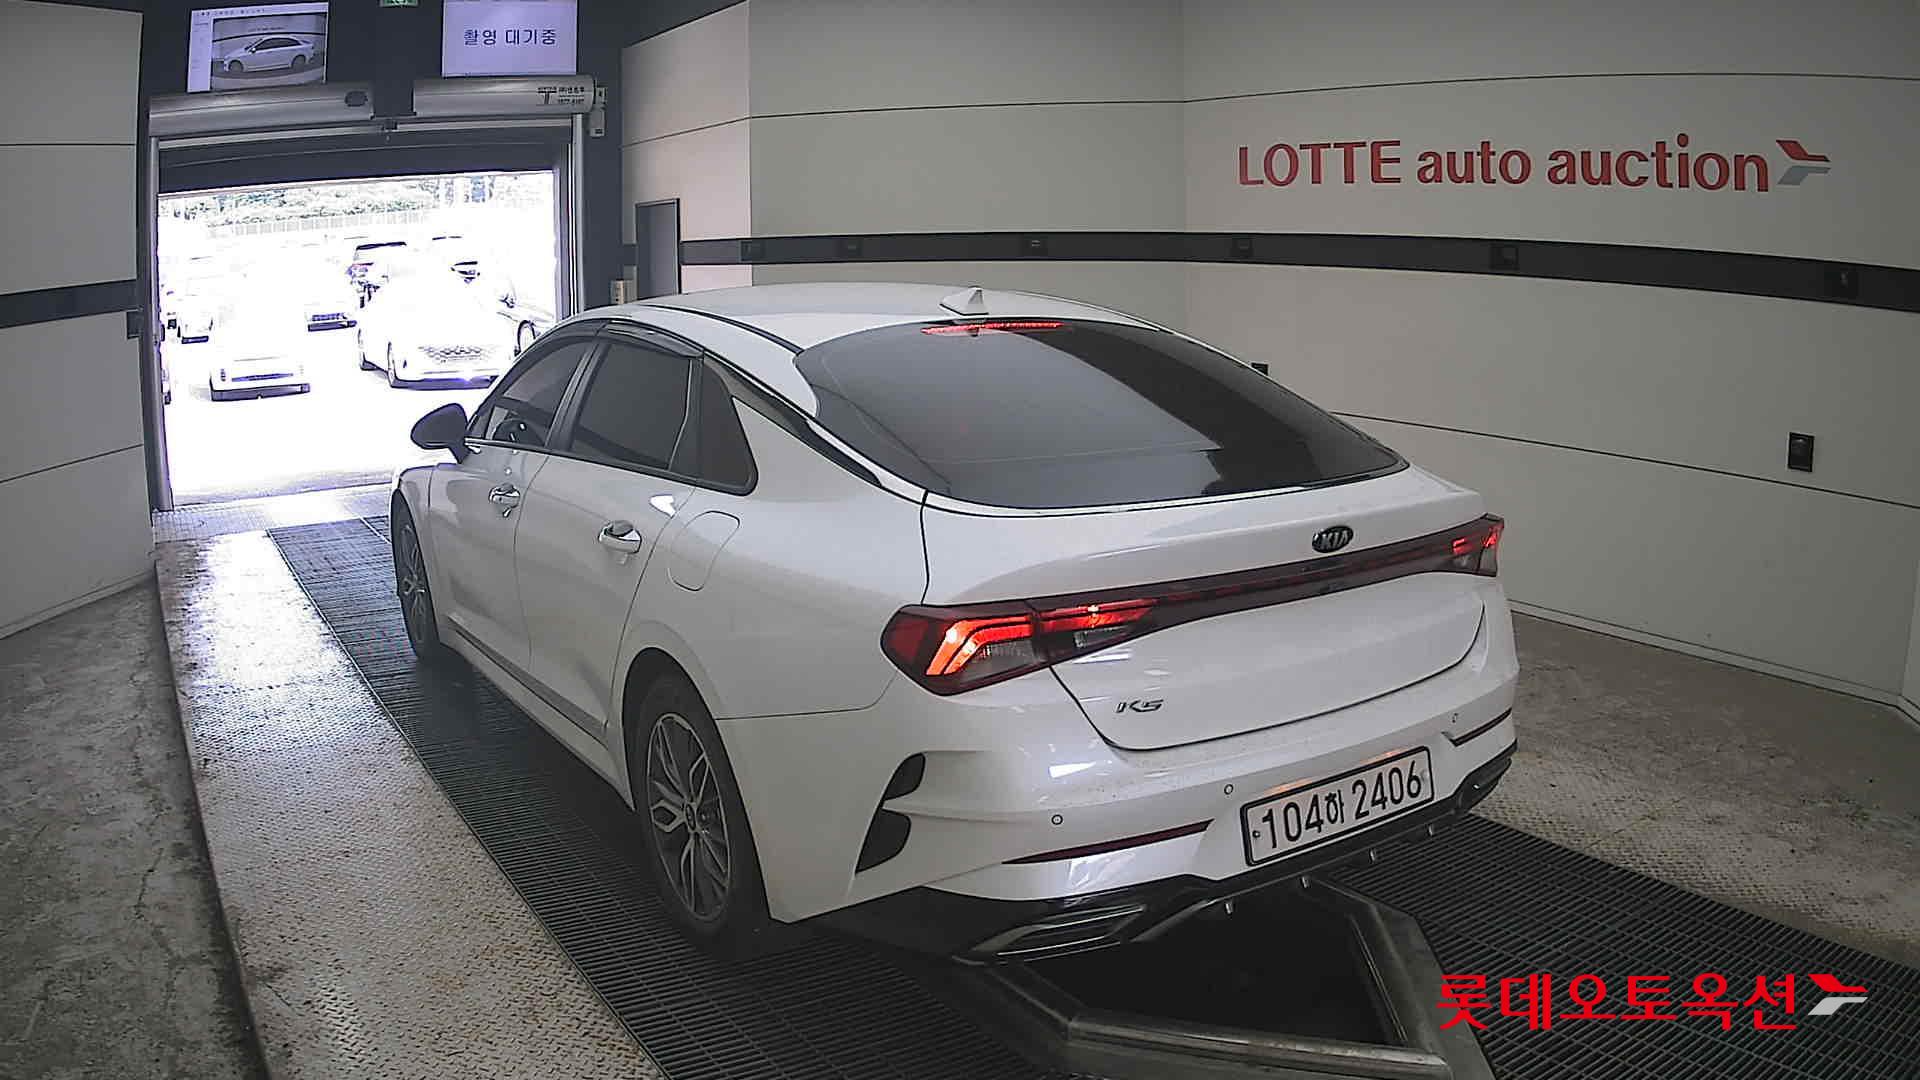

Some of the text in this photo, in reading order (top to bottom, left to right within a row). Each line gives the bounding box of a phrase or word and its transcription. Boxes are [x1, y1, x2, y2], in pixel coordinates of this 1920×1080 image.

[464, 28, 557, 46] 촬영 대기중
[1240, 133, 1769, 192] LOTTE auto auction
[1320, 529, 1349, 550] KIA
[1116, 699, 1164, 713] K5
[1262, 760, 1422, 849] 104하 2406
